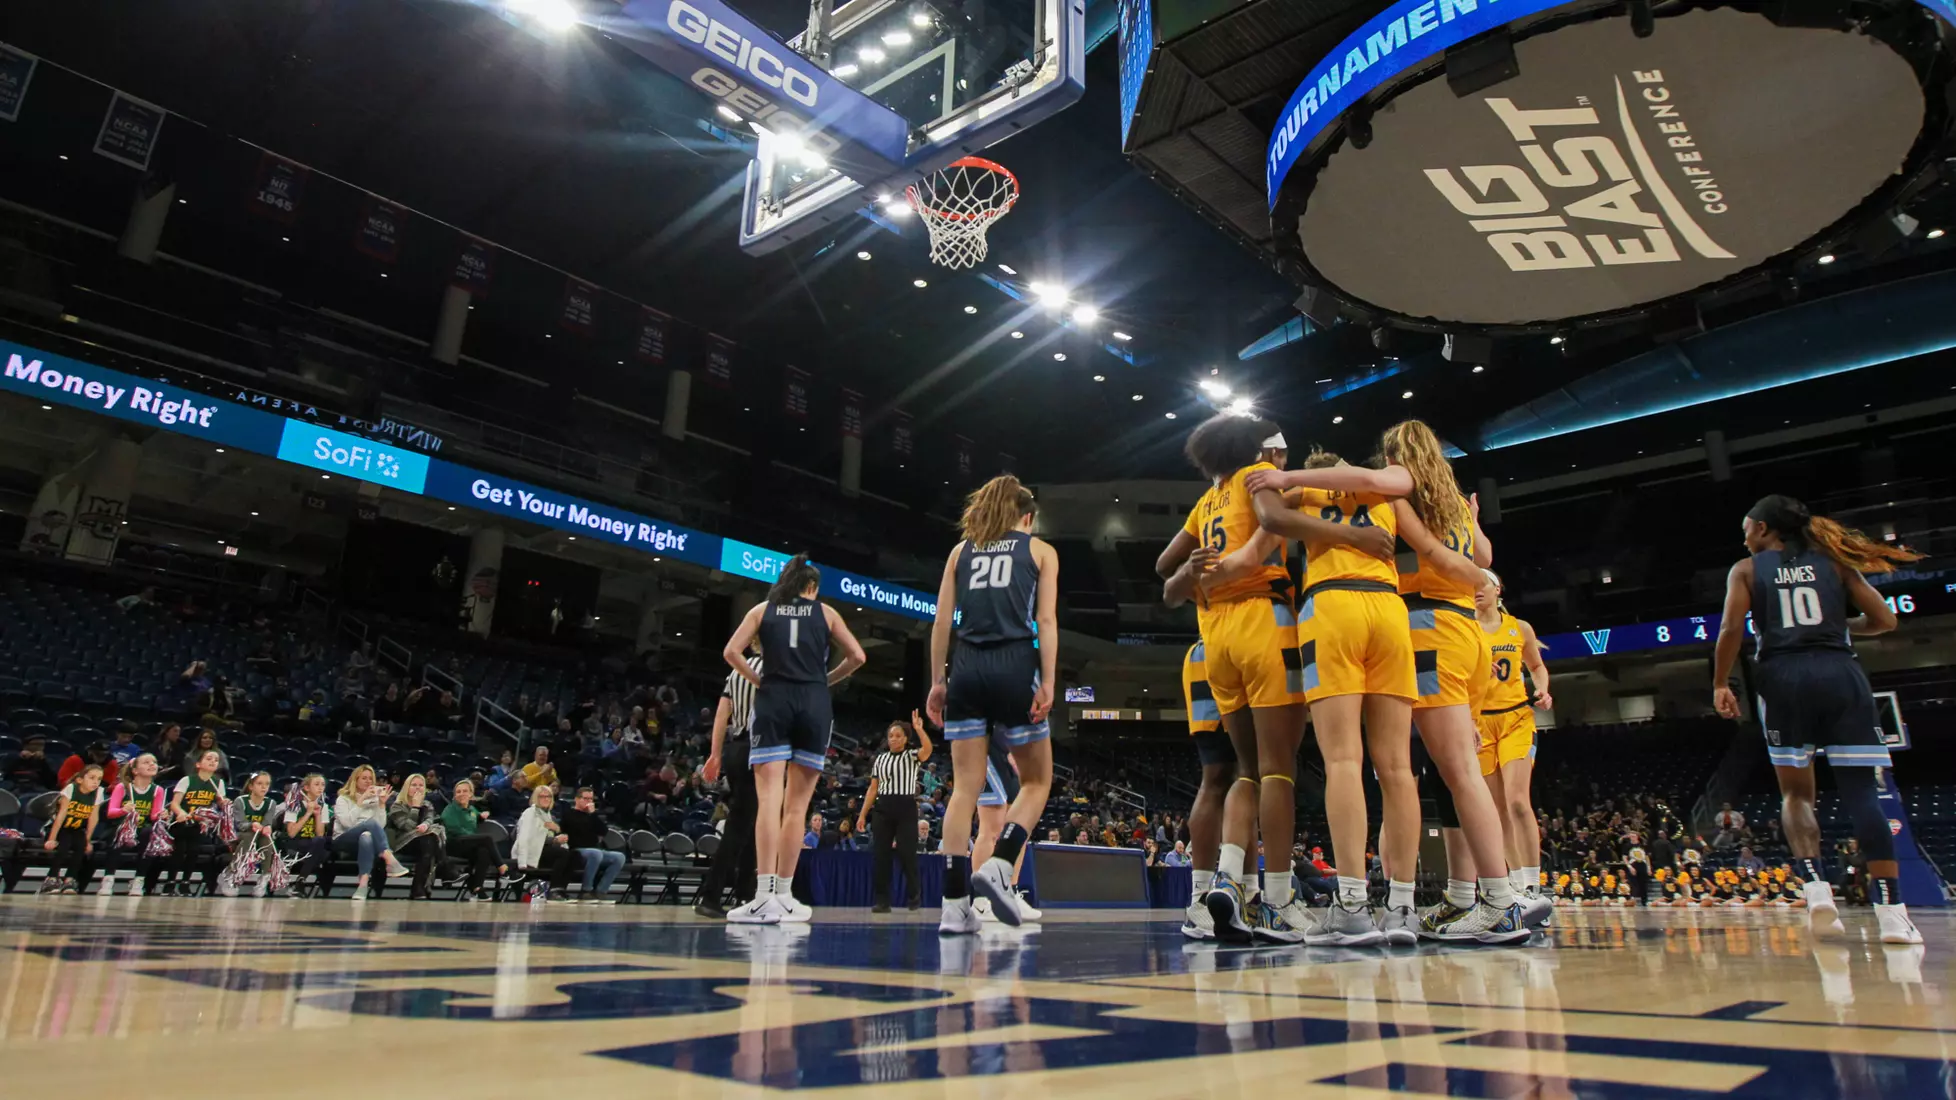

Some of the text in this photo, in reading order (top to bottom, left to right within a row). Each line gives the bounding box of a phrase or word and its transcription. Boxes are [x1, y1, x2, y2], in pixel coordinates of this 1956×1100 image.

[667, 0, 818, 107] GEICO
[1269, 0, 1502, 175] TOURNAMEN
[1632, 69, 1728, 214] CONFERENCE
[1484, 98, 1682, 265] EAST
[257, 191, 293, 212] 1945
[1423, 165, 1596, 271] BIG
[4, 353, 126, 409] Money
[313, 437, 373, 472] SoFi
[471, 479, 512, 506] Get
[518, 490, 565, 519] Your
[568, 504, 635, 541] Money
[1203, 516, 1226, 554] 15
[741, 551, 777, 576] SoFi
[969, 554, 1013, 590] 20
[1774, 565, 1816, 584] JAMES
[776, 604, 813, 617] HERLIHY
[841, 577, 937, 615] Get Your Mone
[1778, 587, 1823, 628] 10
[790, 619, 798, 648] 1
[1656, 625, 1671, 642] 8
[1690, 616, 1706, 624] TOL
[1694, 625, 1708, 640] 4
[64, 817, 83, 829] 14
